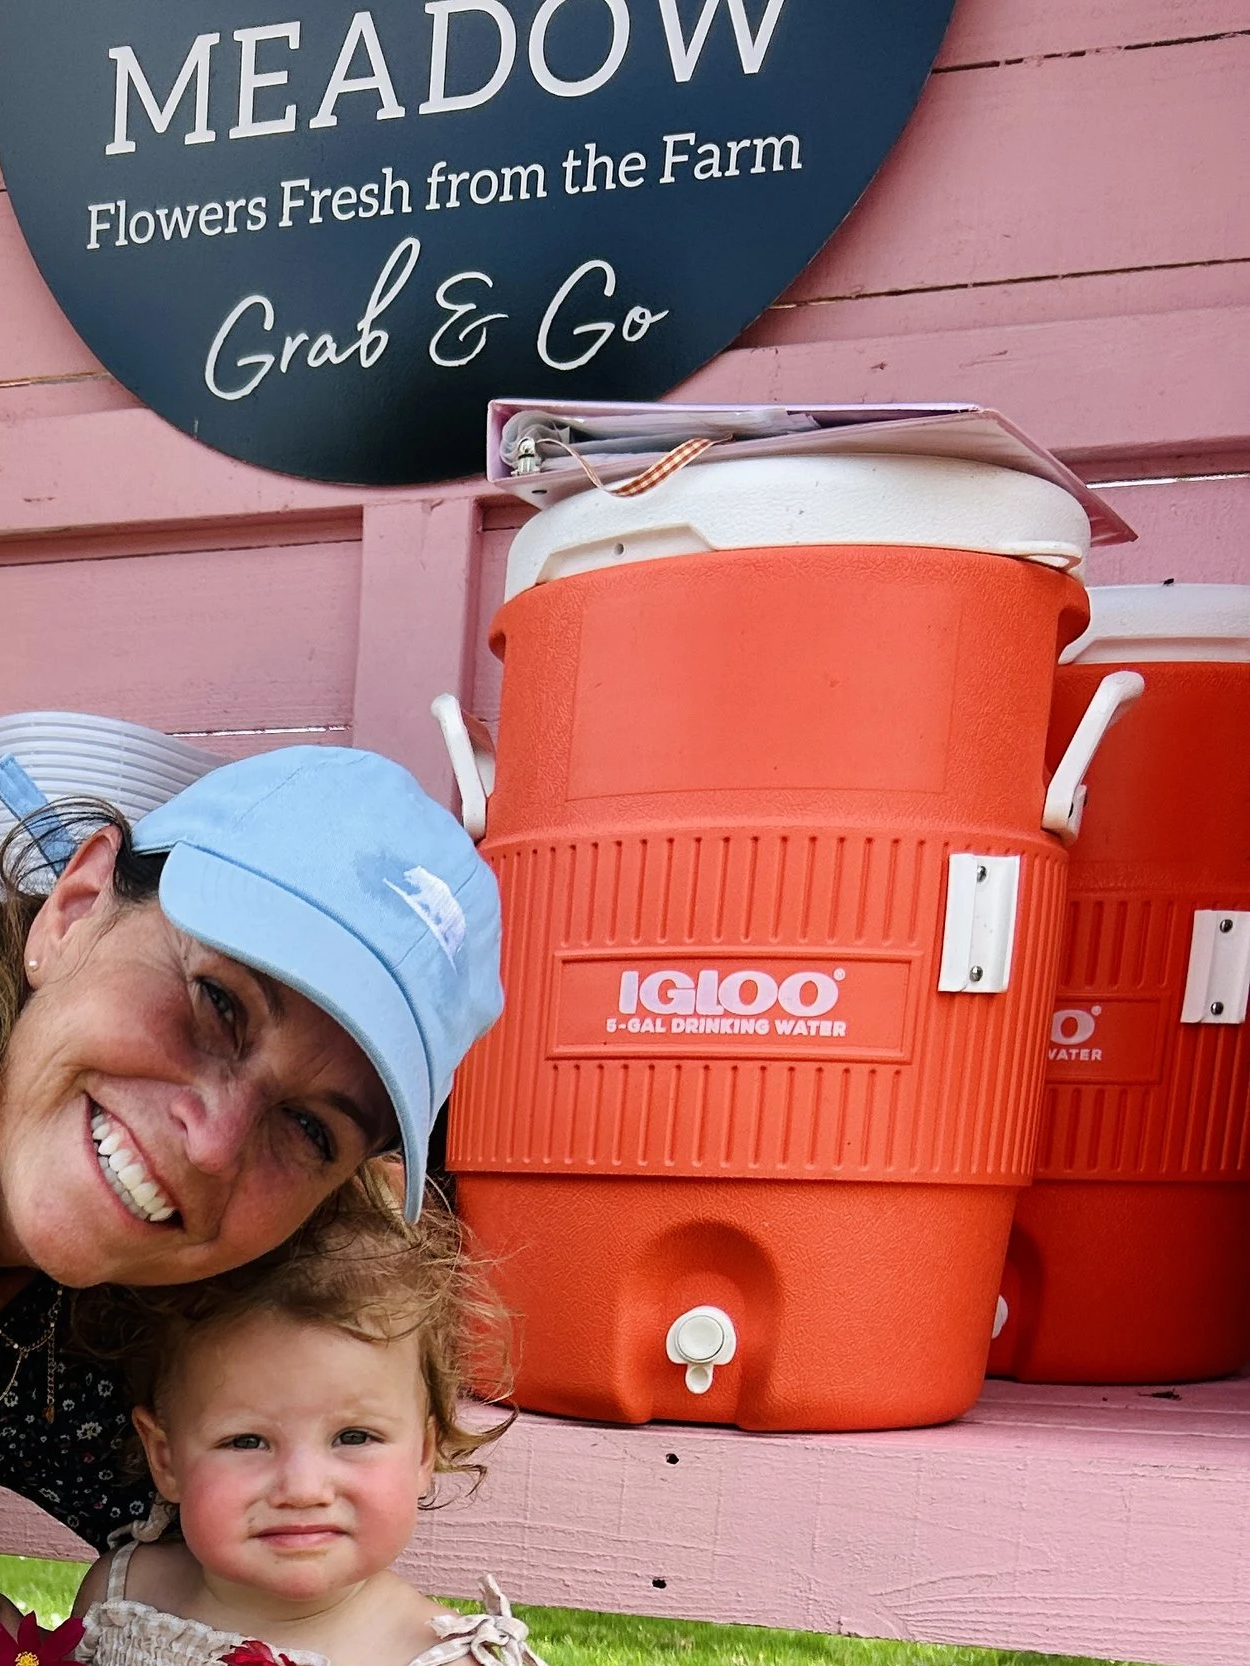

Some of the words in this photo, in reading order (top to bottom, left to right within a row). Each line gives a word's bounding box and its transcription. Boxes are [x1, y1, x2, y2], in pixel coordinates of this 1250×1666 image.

[105, 0, 786, 156] MEADOW
[86, 190, 267, 250] Flowers
[278, 166, 411, 228] Fresh
[425, 155, 547, 211] from
[562, 142, 647, 195] the
[659, 130, 804, 184] Farm
[204, 236, 421, 401] Grab
[429, 271, 510, 367] &
[536, 259, 670, 371] Go
[605, 1017, 667, 1035] 5-GAL
[670, 1017, 771, 1036] DRINKING
[774, 1018, 847, 1038] WATER
